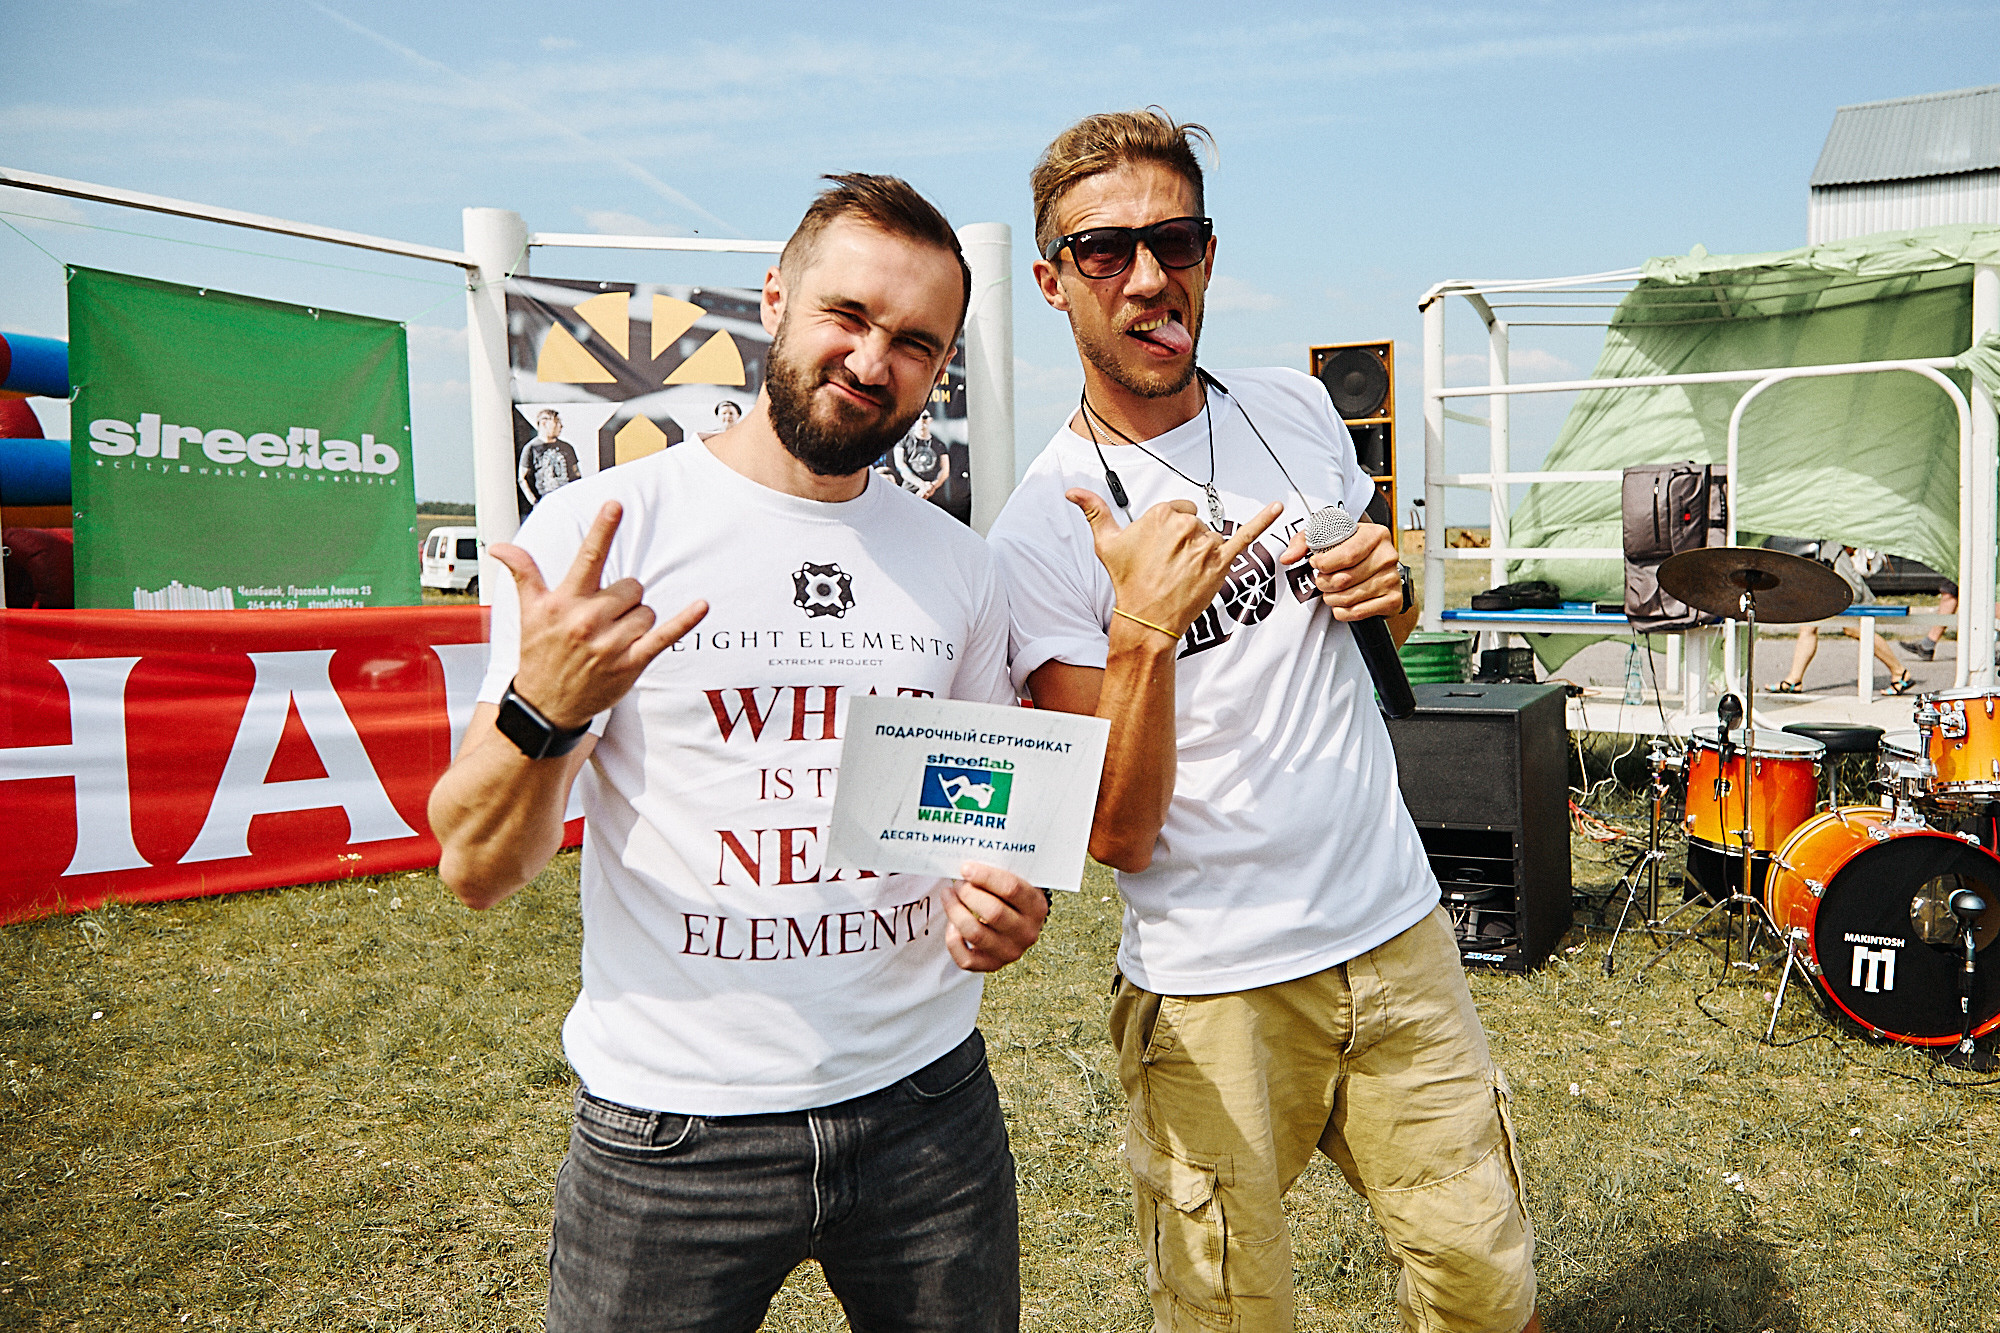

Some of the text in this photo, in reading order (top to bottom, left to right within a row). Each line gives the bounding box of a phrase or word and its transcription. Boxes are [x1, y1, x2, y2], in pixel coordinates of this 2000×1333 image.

[88, 413, 400, 475] streetlab
[112, 460, 169, 475] city
[199, 466, 247, 478] wake
[275, 471, 326, 483] snow
[360, 585, 372, 596] 23
[246, 600, 299, 610] 264-44-67
[799, 631, 954, 661] ELEMENTS
[768, 658, 884, 667] EXTREME PROJECT
[702, 684, 934, 744] WH
[875, 724, 1073, 754] ПОДАРОЧНЫЙ СЕРТИФИКАТ
[926, 753, 1015, 770] streetlab
[757, 767, 795, 801] IS
[918, 808, 1007, 830] WAKEPARK
[879, 829, 1037, 854] ДЕСЯТЬ МИНУТ КАТАНИЯ
[678, 895, 931, 962] ELEMENT?
[1844, 933, 1905, 947] MAKINTOSH
